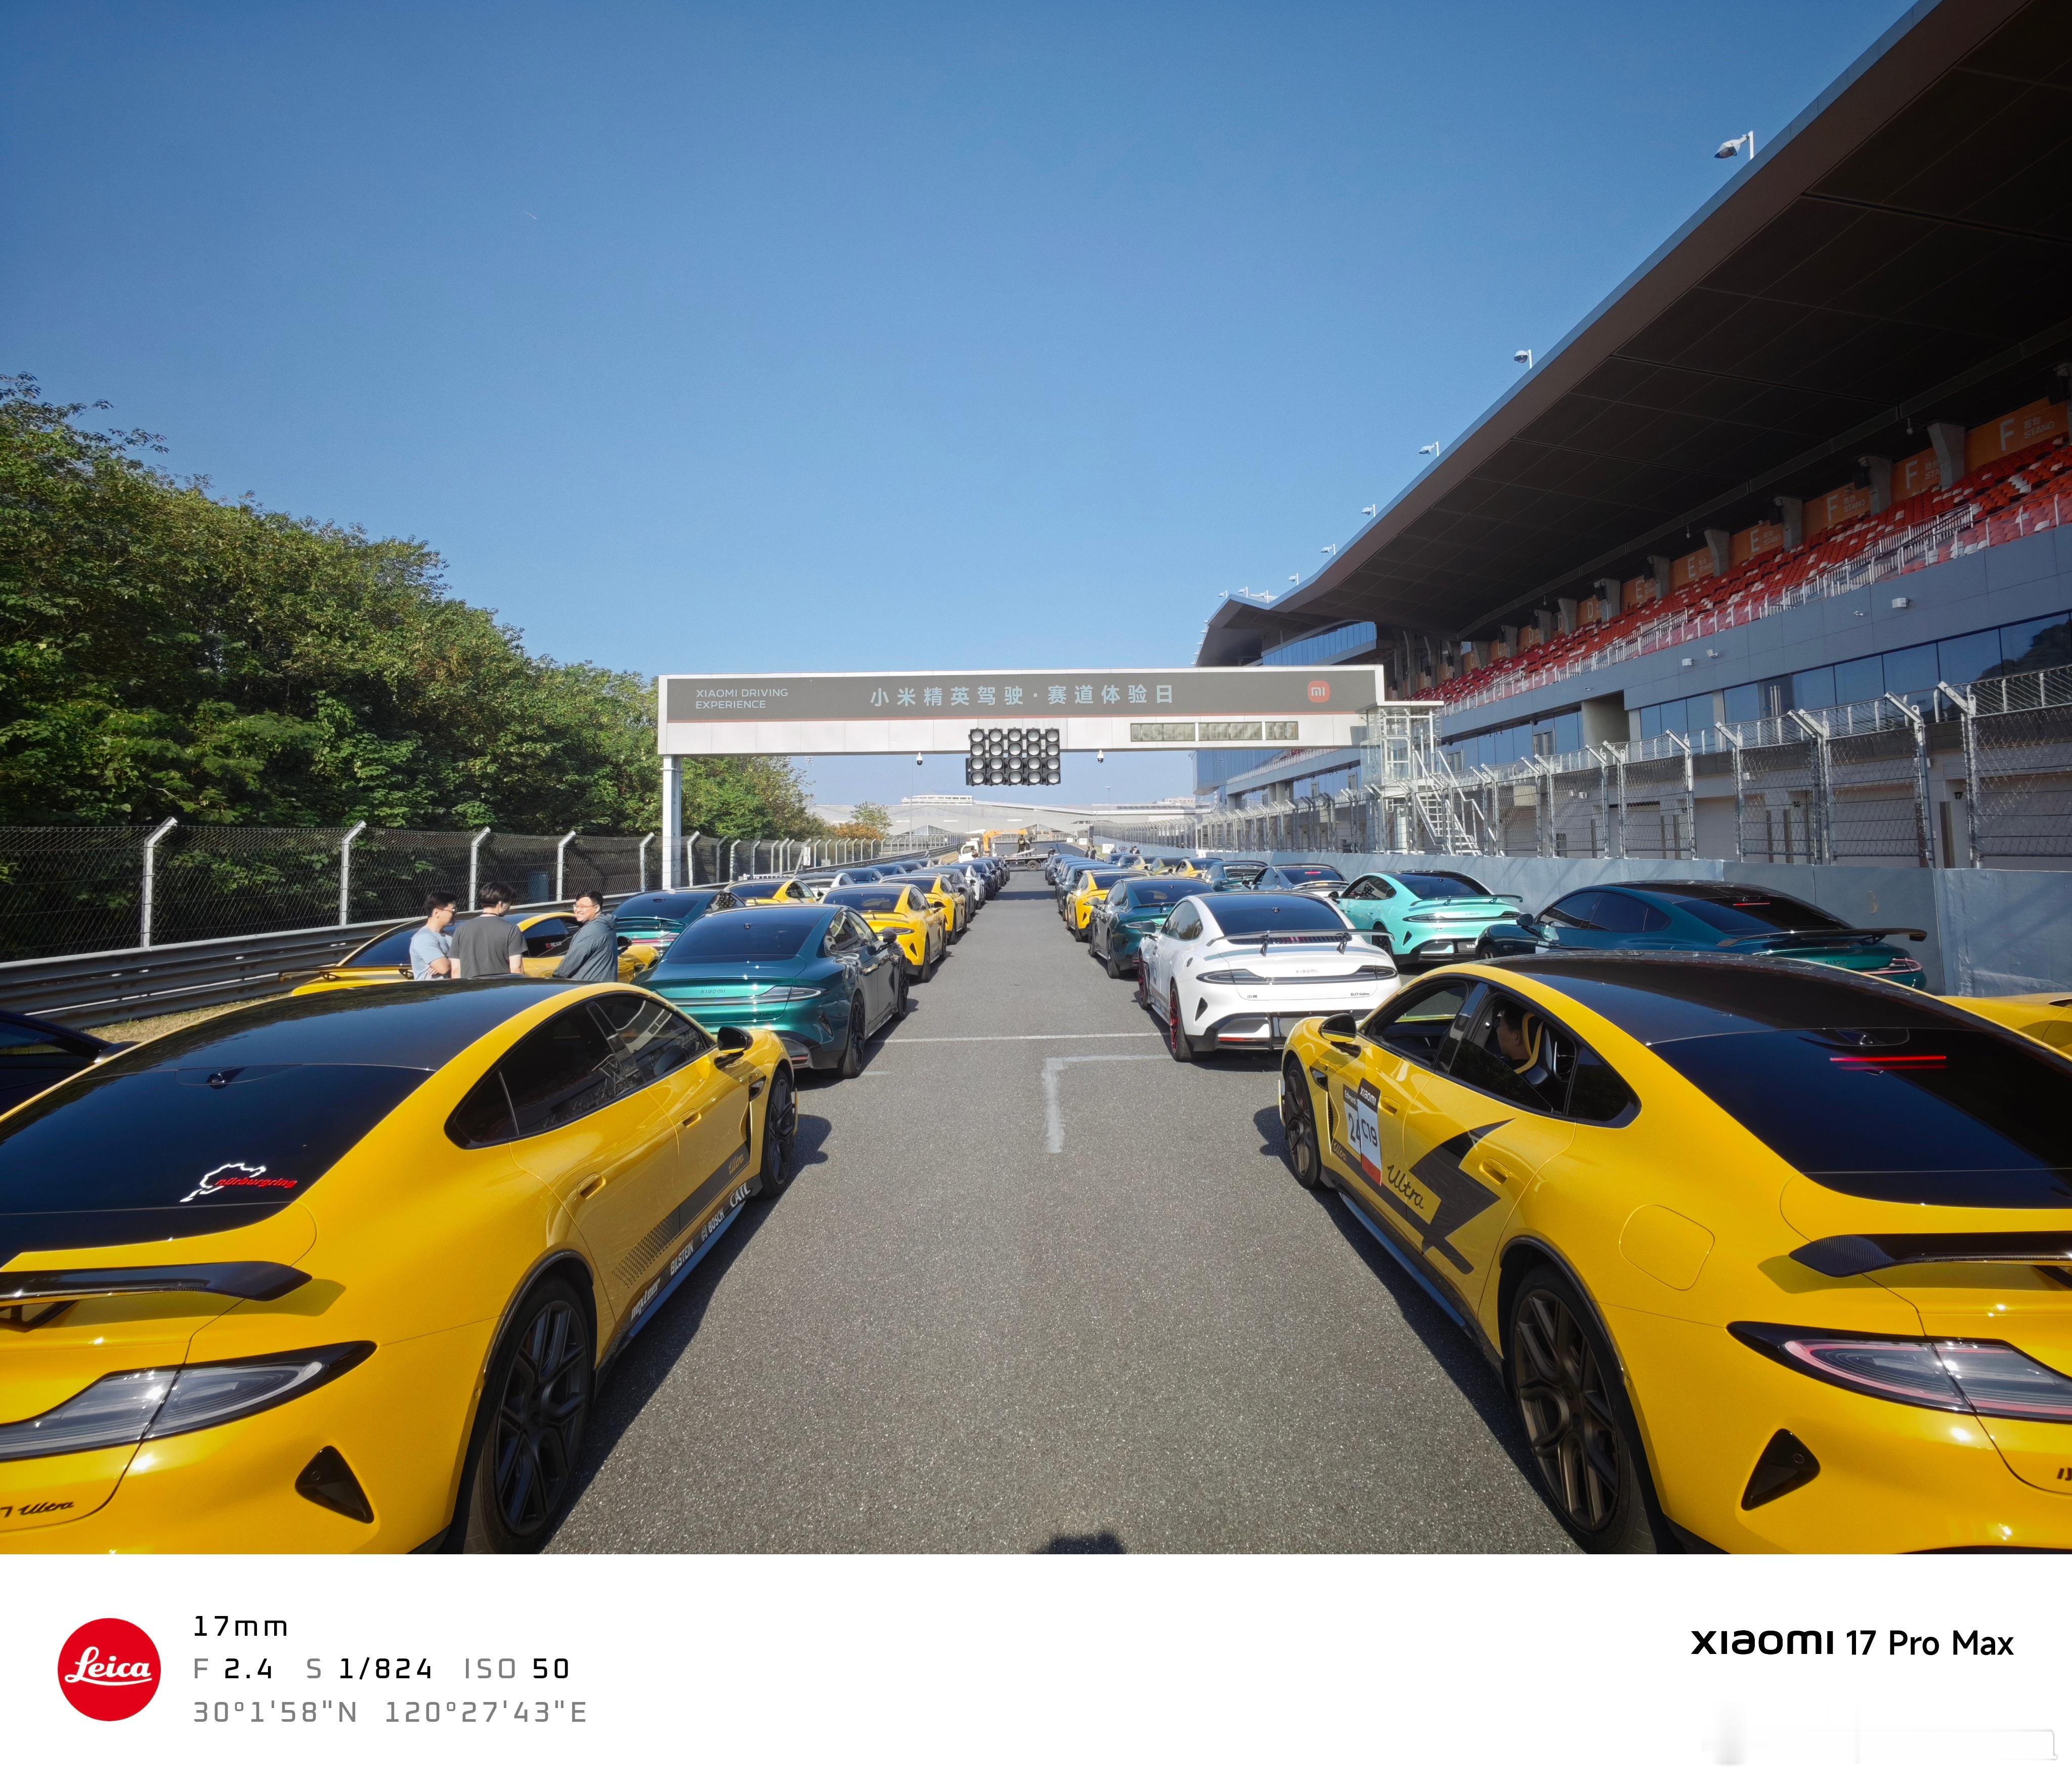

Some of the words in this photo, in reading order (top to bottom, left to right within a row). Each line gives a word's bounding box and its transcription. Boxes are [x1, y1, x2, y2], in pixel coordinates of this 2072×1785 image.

[2000, 417, 2015, 451] F
[1906, 460, 1918, 489] F
[1827, 494, 1838, 522] F
[1750, 528, 1760, 552] E
[1688, 557, 1696, 578] E
[1635, 580, 1644, 599] E
[1558, 614, 1563, 631] D
[1587, 601, 1593, 619] D
[696, 689, 739, 698] XIAOMI
[742, 688, 789, 698] DRIVING
[696, 700, 766, 709] EXPERIENCE
[1361, 1119, 1377, 1148] C19
[730, 1182, 751, 1208] CATL
[1387, 1164, 1424, 1210] Ultra
[708, 1206, 725, 1234] BOSCH
[670, 1239, 694, 1276] BILSTEIN
[18, 1501, 74, 1515] Ultra
